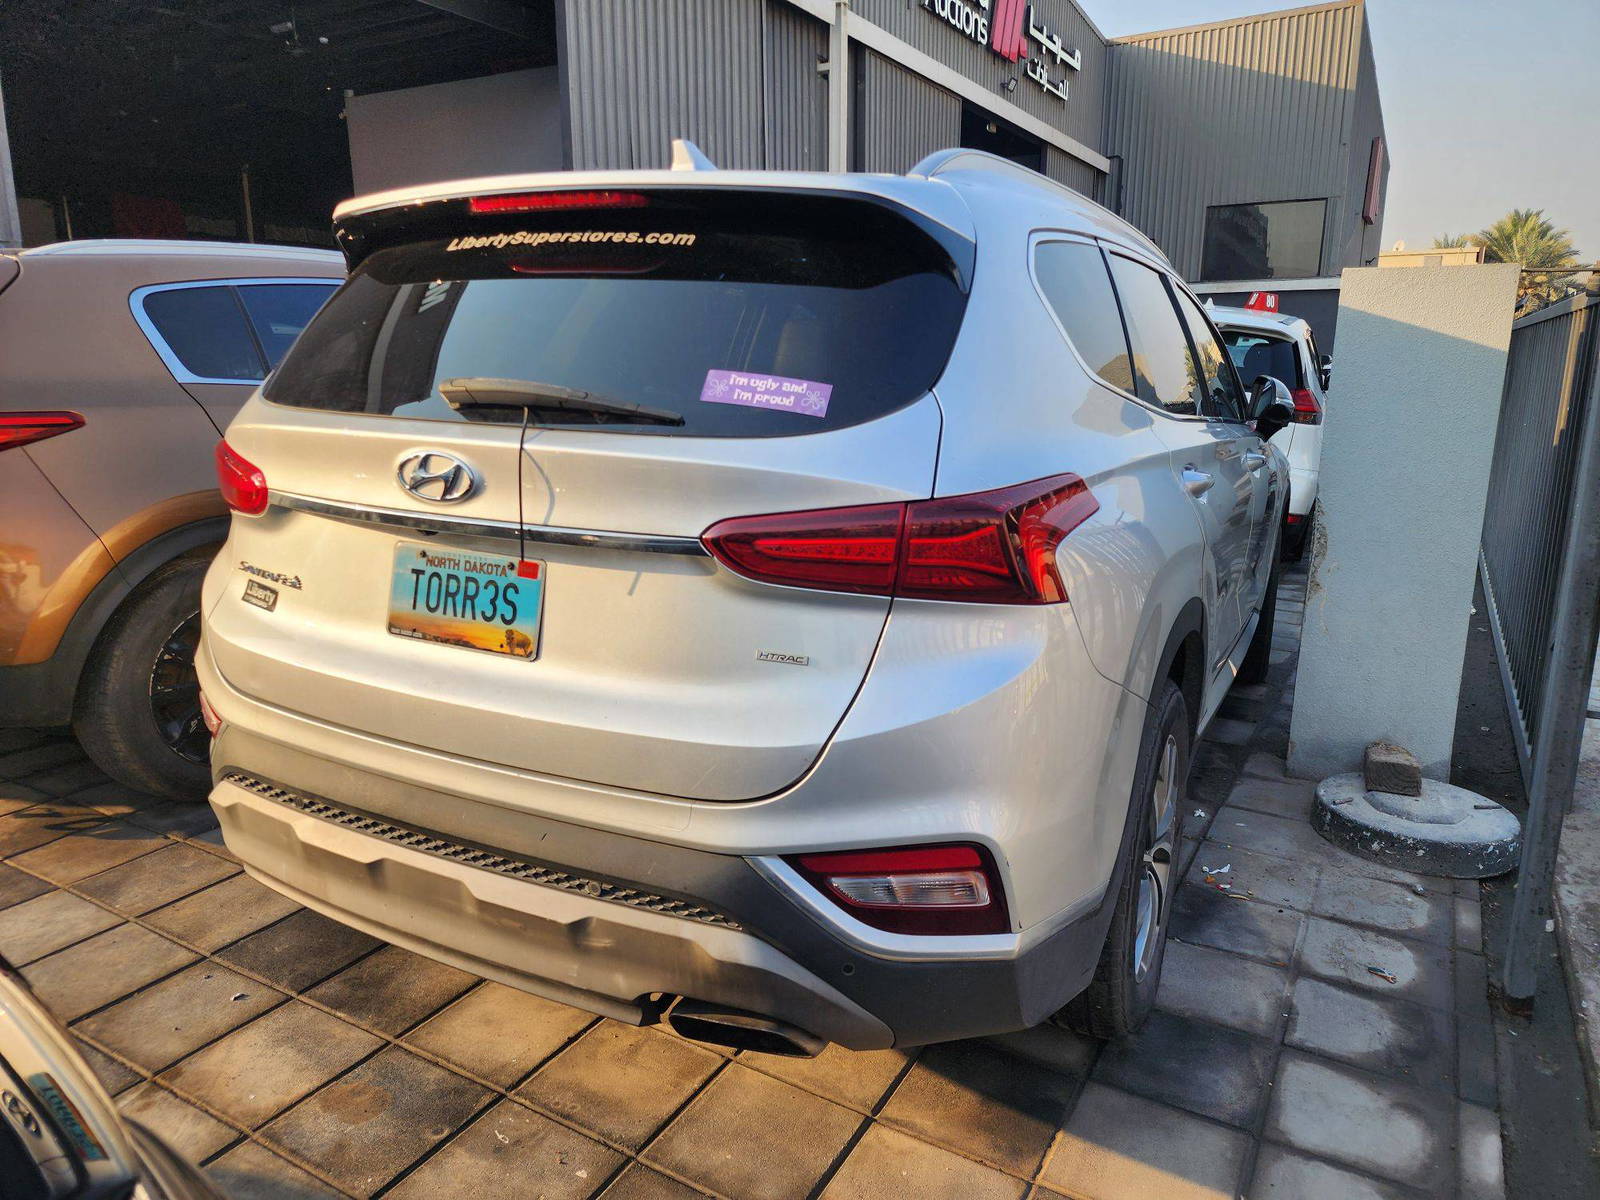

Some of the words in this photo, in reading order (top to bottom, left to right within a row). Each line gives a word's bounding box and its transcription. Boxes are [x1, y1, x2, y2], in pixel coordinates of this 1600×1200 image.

[447, 231, 696, 252] LibertySuperstores.com
[1266, 294, 1275, 308] 80
[750, 378, 779, 392] ugly
[782, 382, 808, 394] and
[753, 393, 805, 407] proud
[425, 555, 460, 571] NORTH
[463, 560, 508, 577] DAKOTA
[410, 568, 520, 626] TORR3S
[759, 651, 804, 664] HTRAC
